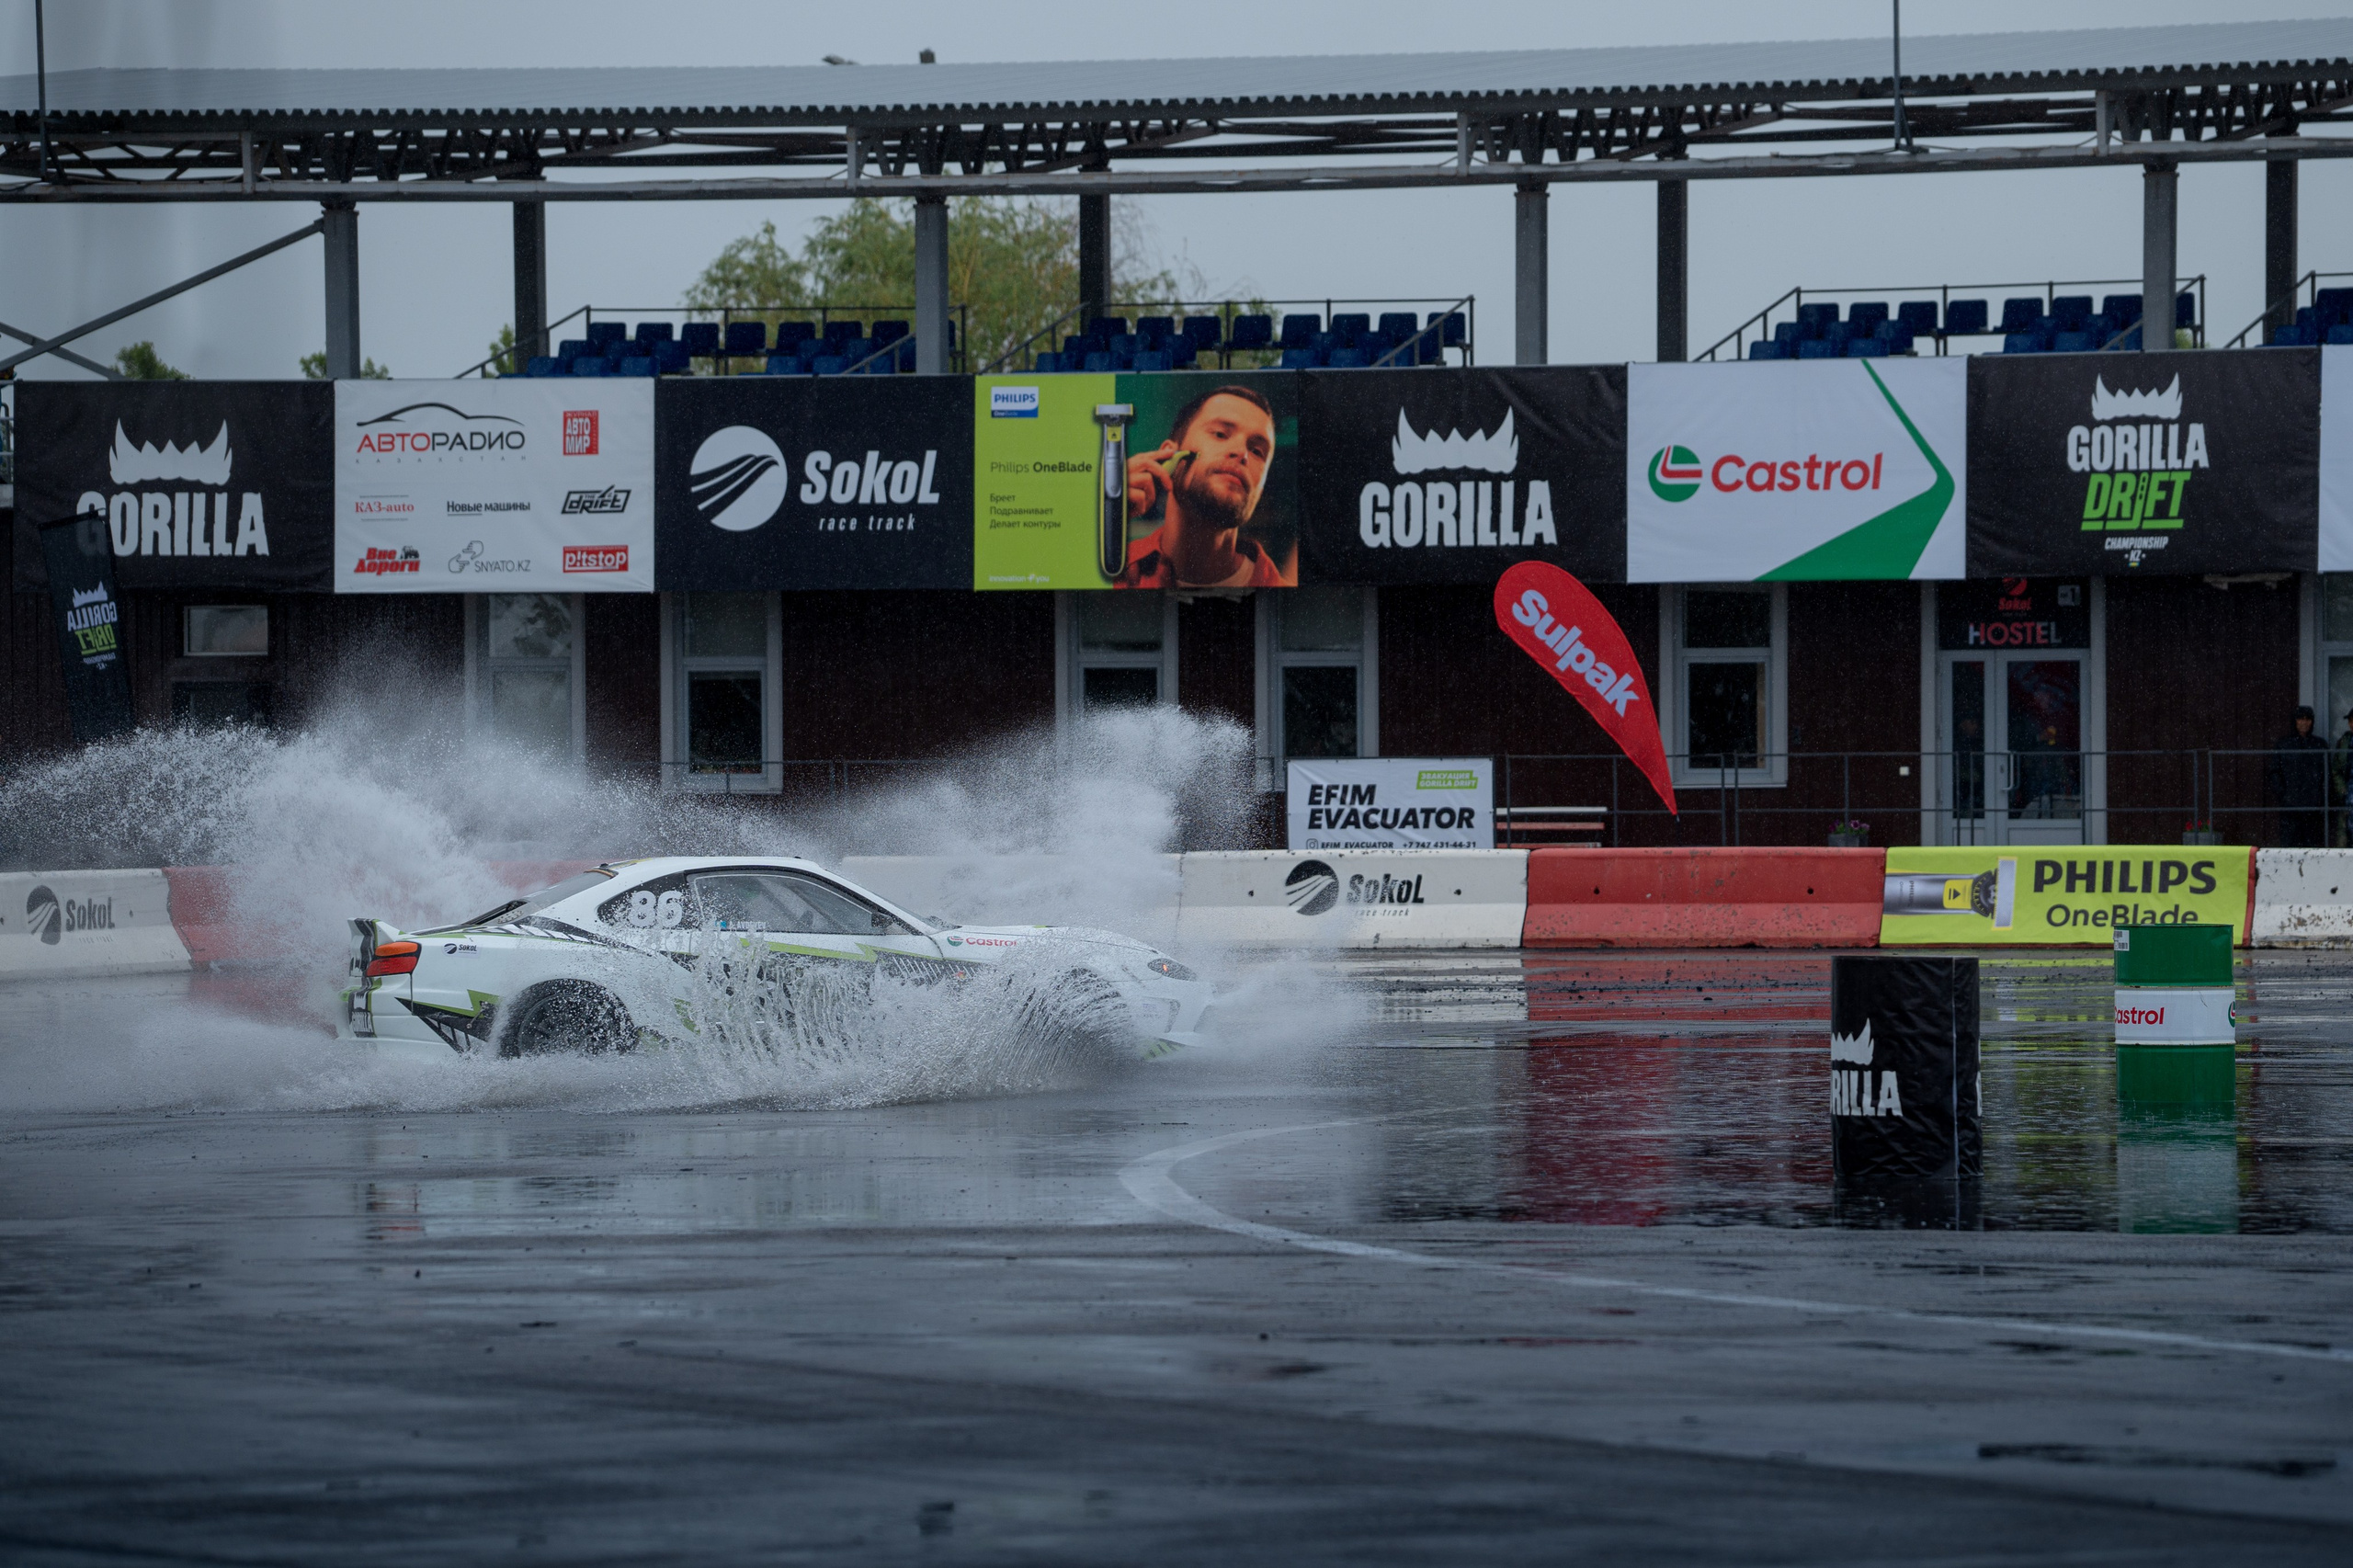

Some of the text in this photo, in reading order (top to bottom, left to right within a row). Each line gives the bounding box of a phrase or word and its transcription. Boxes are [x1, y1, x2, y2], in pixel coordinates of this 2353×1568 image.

[994, 393, 1036, 403] PHILIPS
[566, 417, 591, 435] АВТО
[565, 436, 590, 454] МИР
[2067, 423, 2210, 472] GORILLA
[990, 461, 1092, 474] Philips OneBlade
[1711, 451, 1883, 493] Castrol
[355, 501, 415, 513] КАЗ-auto
[447, 501, 530, 513] Новые машины
[990, 494, 1016, 502] Бреет
[2081, 471, 2192, 531] DRIFT
[990, 506, 1053, 517] Подравнивает
[1359, 480, 1558, 549] GORILLA
[819, 513, 915, 531] race track
[990, 519, 1061, 529] Делает контуры
[2105, 536, 2169, 550] CHAMPIONSHIP
[366, 547, 397, 560] Вне
[354, 558, 421, 576] Дороги
[474, 560, 531, 574] SNYATO.KZ
[1036, 575, 1050, 584] you
[1969, 621, 2062, 645] HOSTEL
[1512, 589, 1640, 718] Sulpak
[1420, 778, 1476, 788] GORILLA DRIFT
[1308, 784, 1377, 805] EFIM
[1308, 807, 1475, 829] EVACUATOR
[2033, 859, 2217, 894] PHILIPS
[628, 890, 683, 928] 86
[1380, 908, 1409, 916] track
[2046, 903, 2199, 926] OneBlade
[966, 937, 1017, 947] Castrol
[2115, 1006, 2165, 1025] astrol
